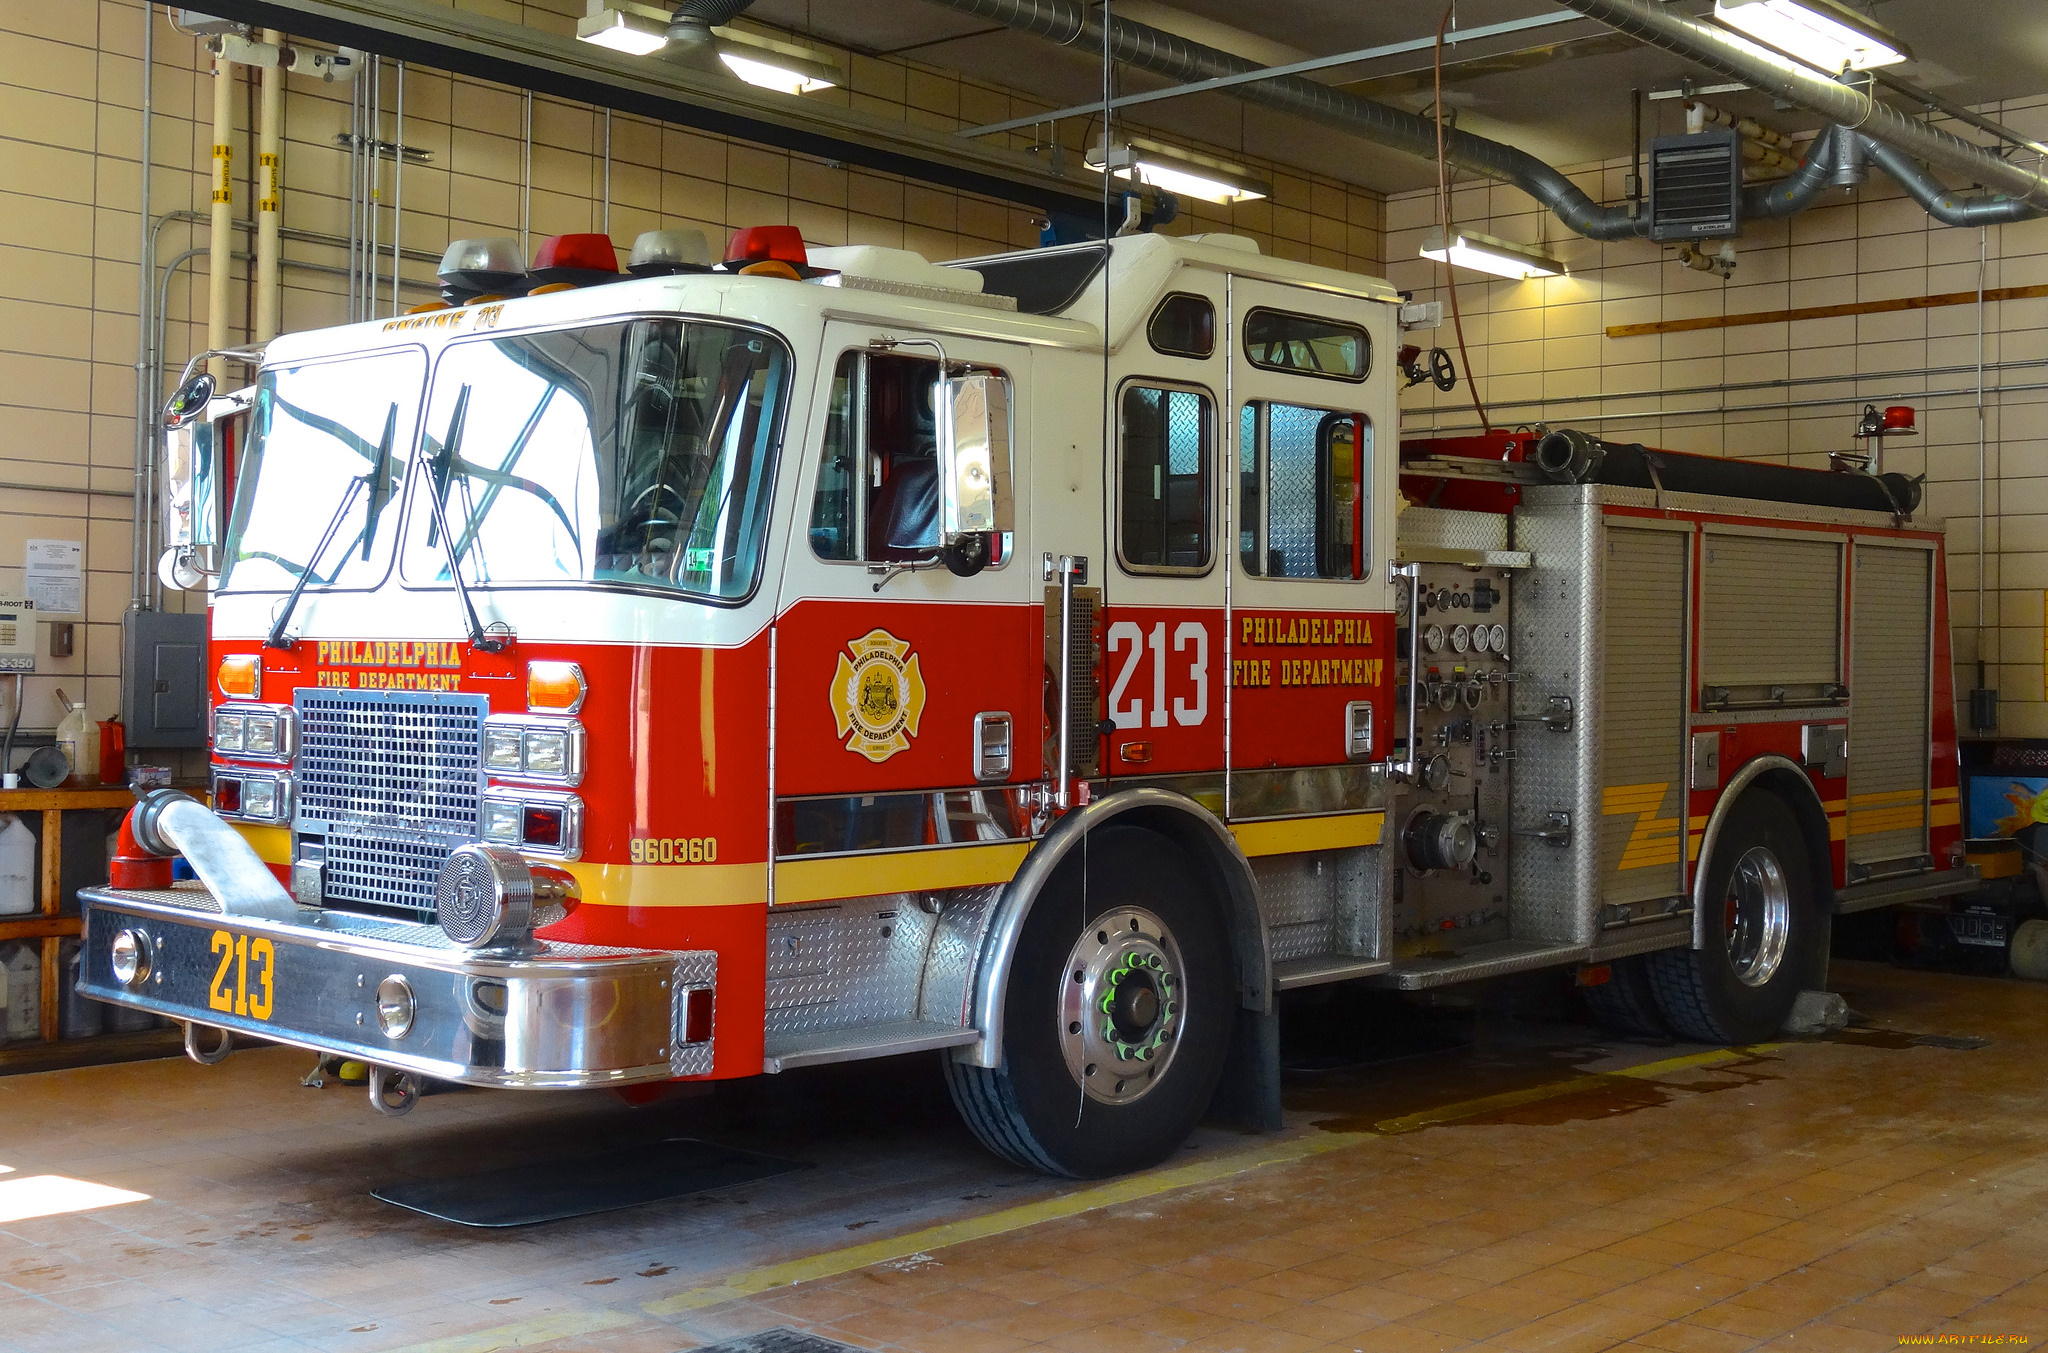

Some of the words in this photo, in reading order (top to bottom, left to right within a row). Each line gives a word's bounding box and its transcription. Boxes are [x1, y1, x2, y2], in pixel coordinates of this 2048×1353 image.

[382, 310, 468, 332] ENGINE
[1241, 617, 1372, 646] PHILADELPHIA
[317, 641, 461, 668] PHILADELPHIA
[853, 650, 904, 672] PHILADELPHIA
[317, 671, 350, 689] FIRE
[358, 672, 461, 692] DEPARTMENT
[1107, 621, 1208, 729] 213
[1232, 659, 1271, 688] FIRE
[1281, 658, 1383, 687] DEPARTMENT
[849, 712, 862, 733] FIRE
[863, 711, 909, 740] DEPARTMENT
[629, 837, 717, 864] 960360
[209, 929, 275, 1021] 213
